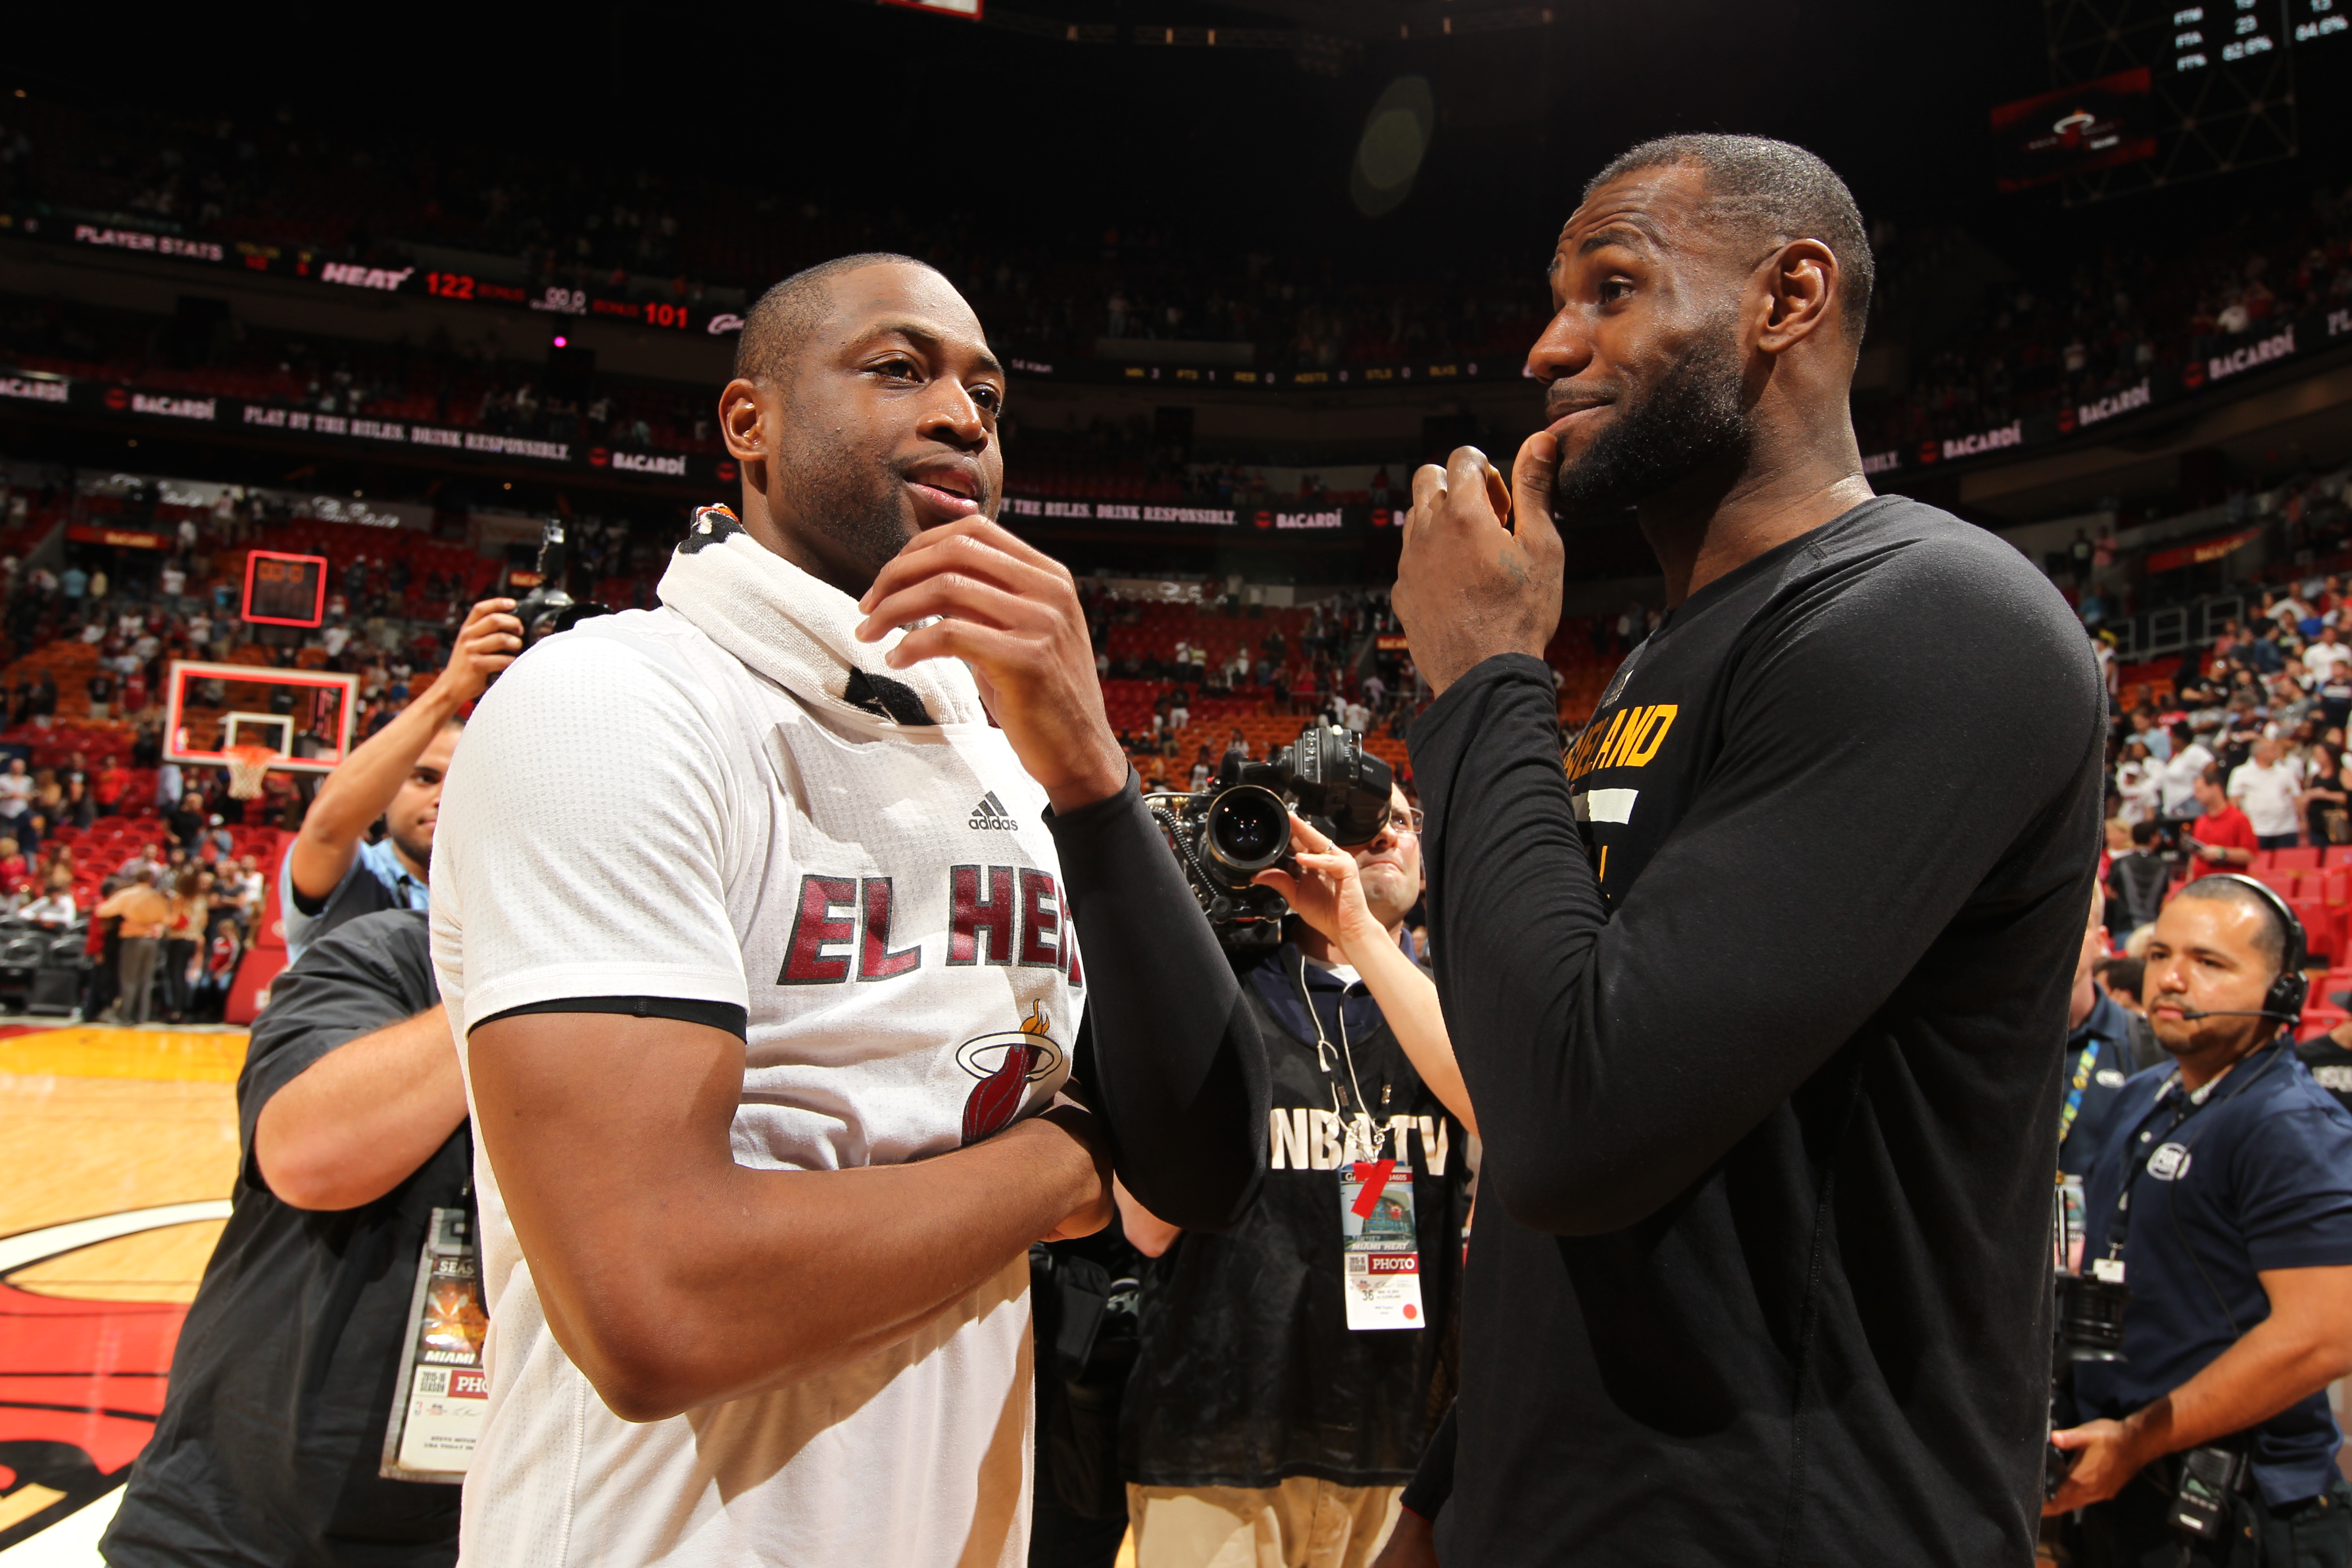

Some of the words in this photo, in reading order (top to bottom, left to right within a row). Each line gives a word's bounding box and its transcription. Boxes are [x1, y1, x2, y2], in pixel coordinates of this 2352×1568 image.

[74, 224, 157, 251] PLAYER
[158, 235, 224, 261] STATS
[320, 261, 416, 291] HEAT
[424, 271, 475, 301] 122
[643, 301, 688, 329] 101
[243, 404, 287, 428] PLAY
[1014, 498, 1042, 516] THE
[1096, 503, 1141, 520] DRINK
[968, 816, 1018, 831] adidas
[776, 874, 921, 985] EL
[1271, 1108, 1375, 1170] NBA
[1390, 1114, 1448, 1176] TV
[1351, 1242, 1382, 1251] MIAMI
[1384, 1240, 1410, 1251] HEAT
[1372, 1257, 1415, 1270] PHOTO
[1362, 1289, 1374, 1301] 36
[424, 1349, 477, 1365] MIAMI
